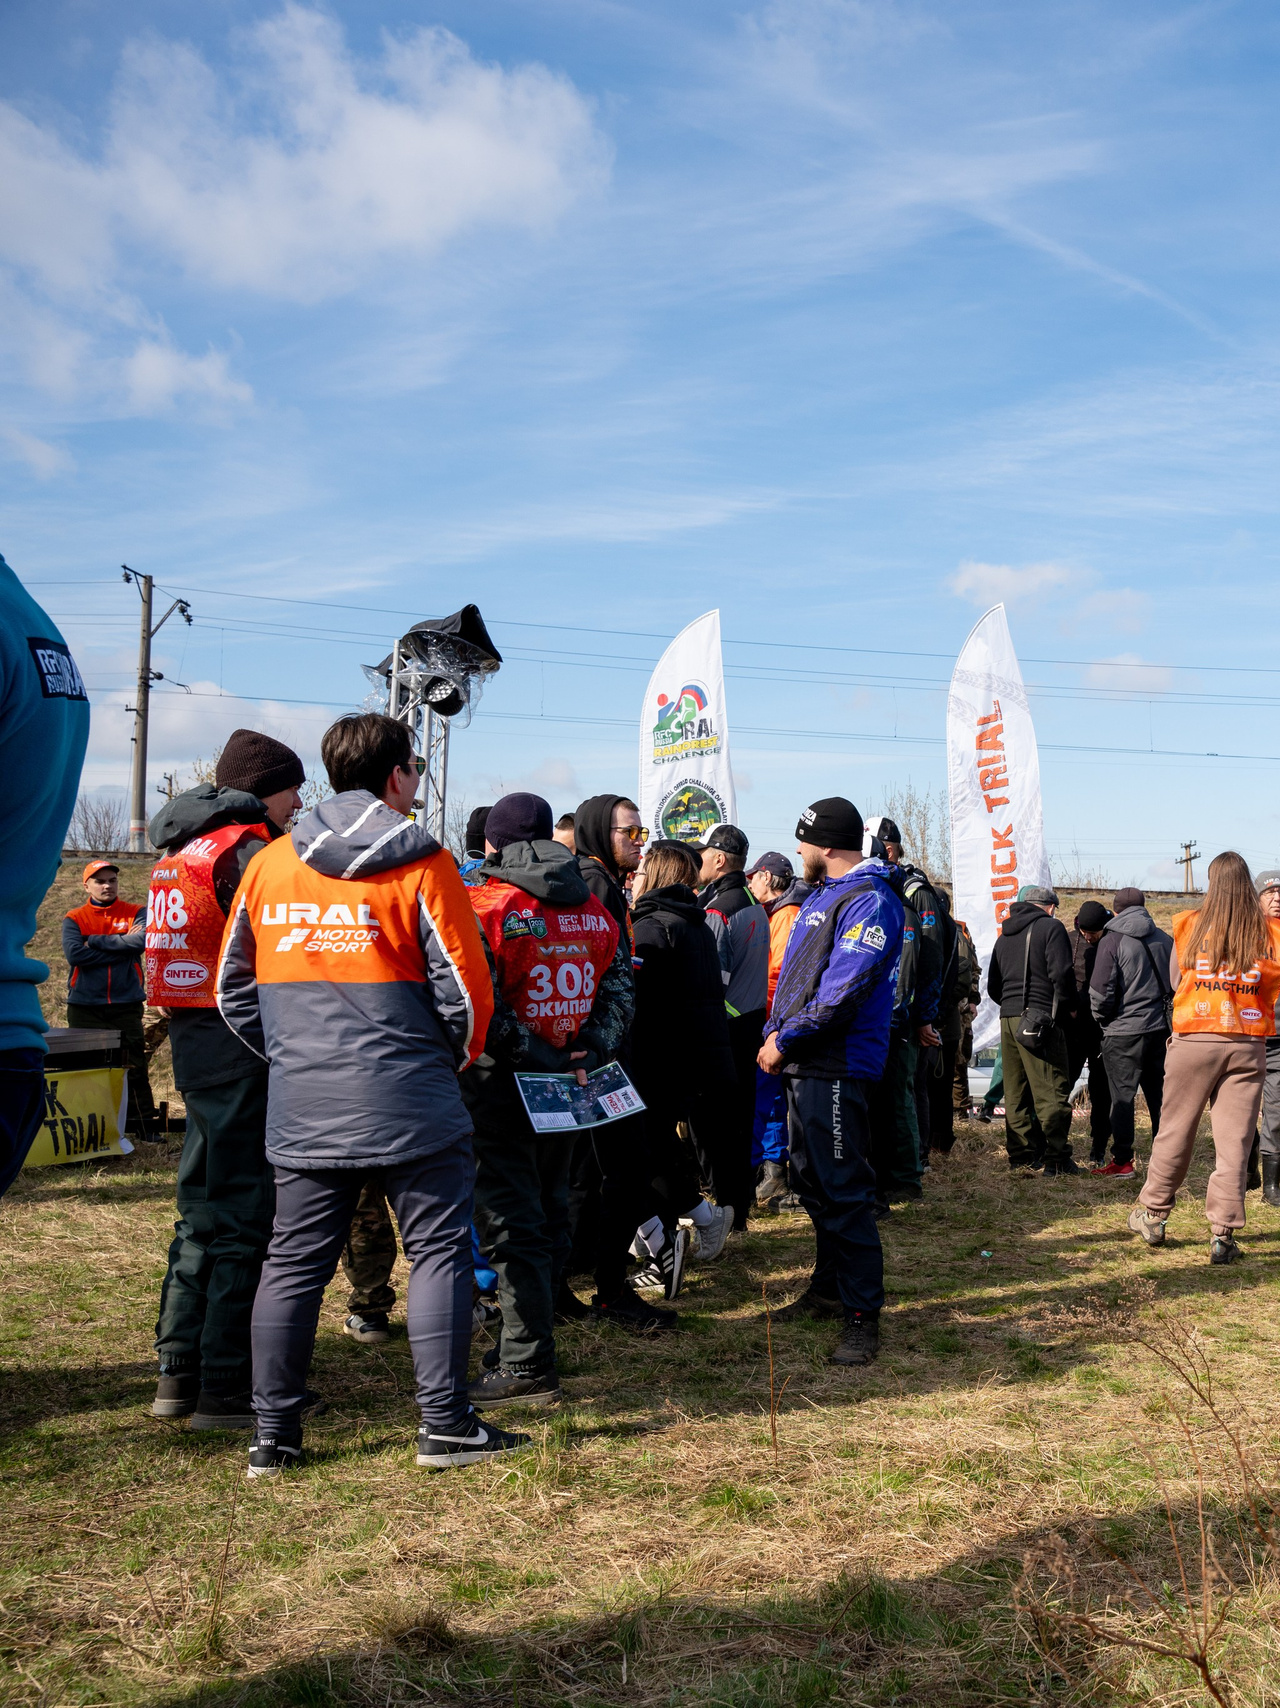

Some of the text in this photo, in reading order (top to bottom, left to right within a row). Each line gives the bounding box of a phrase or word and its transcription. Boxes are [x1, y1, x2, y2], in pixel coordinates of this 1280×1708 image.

[681, 718, 717, 741] RAL
[653, 736, 718, 757] RAINOREST
[975, 699, 1019, 936] RUCK TRIAL
[261, 903, 380, 926] URAL
[145, 932, 189, 950] кипаж
[312, 929, 379, 941] MOTOR
[304, 941, 372, 953] SPORT
[539, 944, 589, 957] УРАЛ
[165, 969, 205, 979] SINTEC
[527, 961, 595, 1000] 308
[1194, 981, 1260, 996] УЧАСТНИК
[832, 1080, 844, 1159] FINNTRAIL
[43, 1113, 111, 1156] TRIAL
[260, 1438, 276, 1446] NIKE
